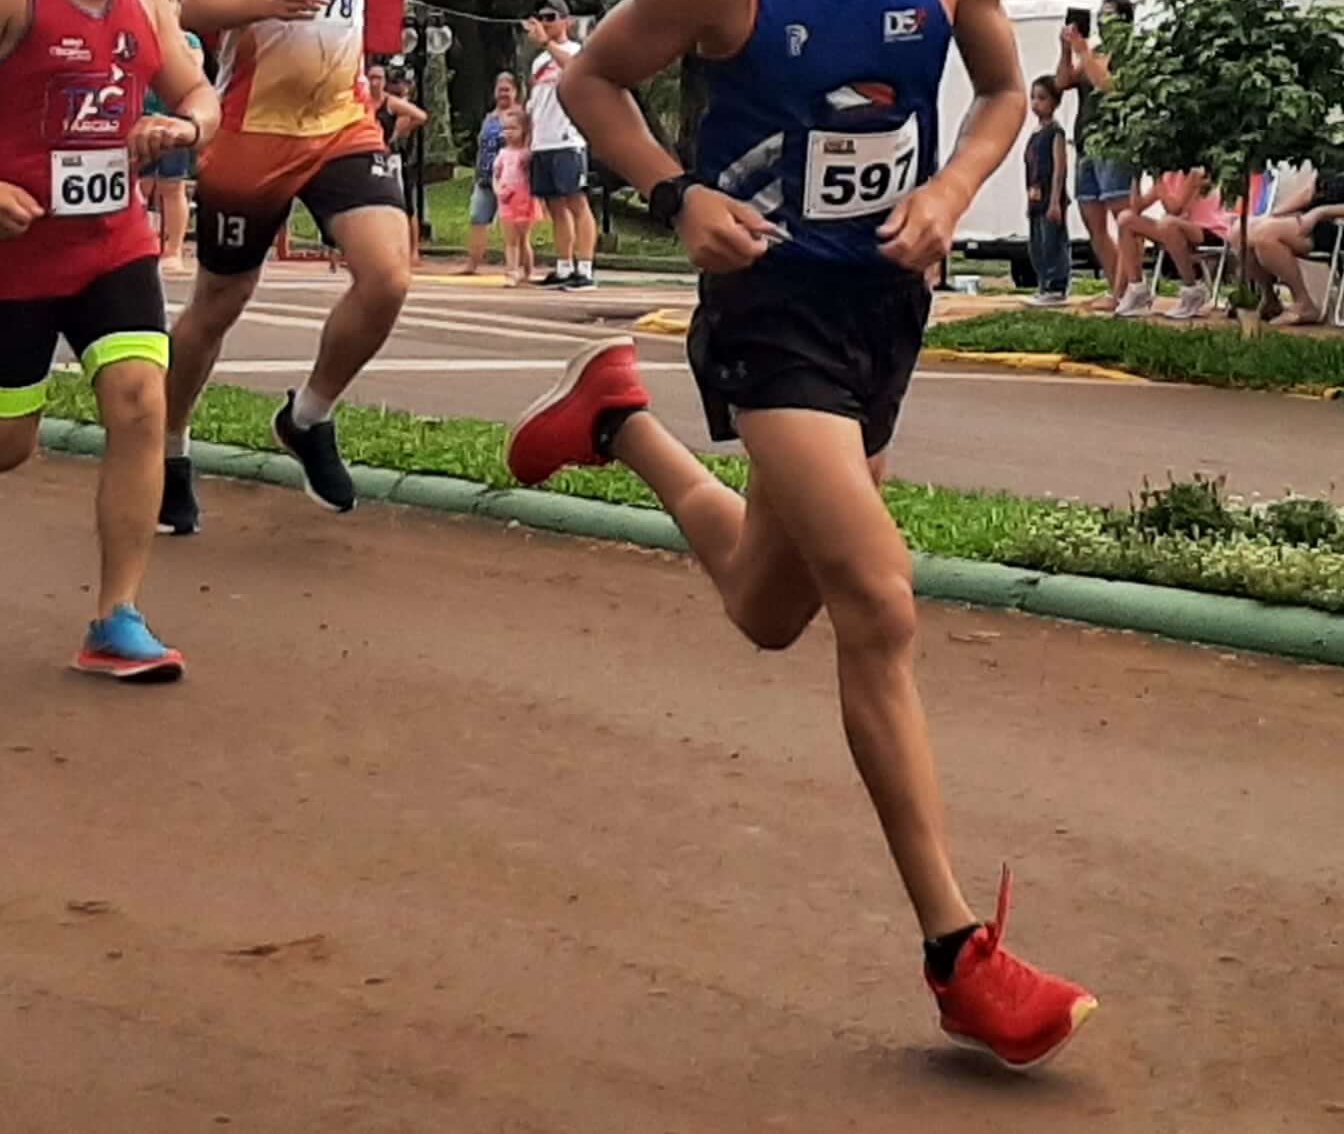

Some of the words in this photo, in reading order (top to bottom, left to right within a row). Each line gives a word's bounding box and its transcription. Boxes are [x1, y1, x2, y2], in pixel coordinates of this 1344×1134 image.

[61, 171, 126, 206] 606
[820, 147, 916, 207] 597
[216, 211, 246, 247] 13
